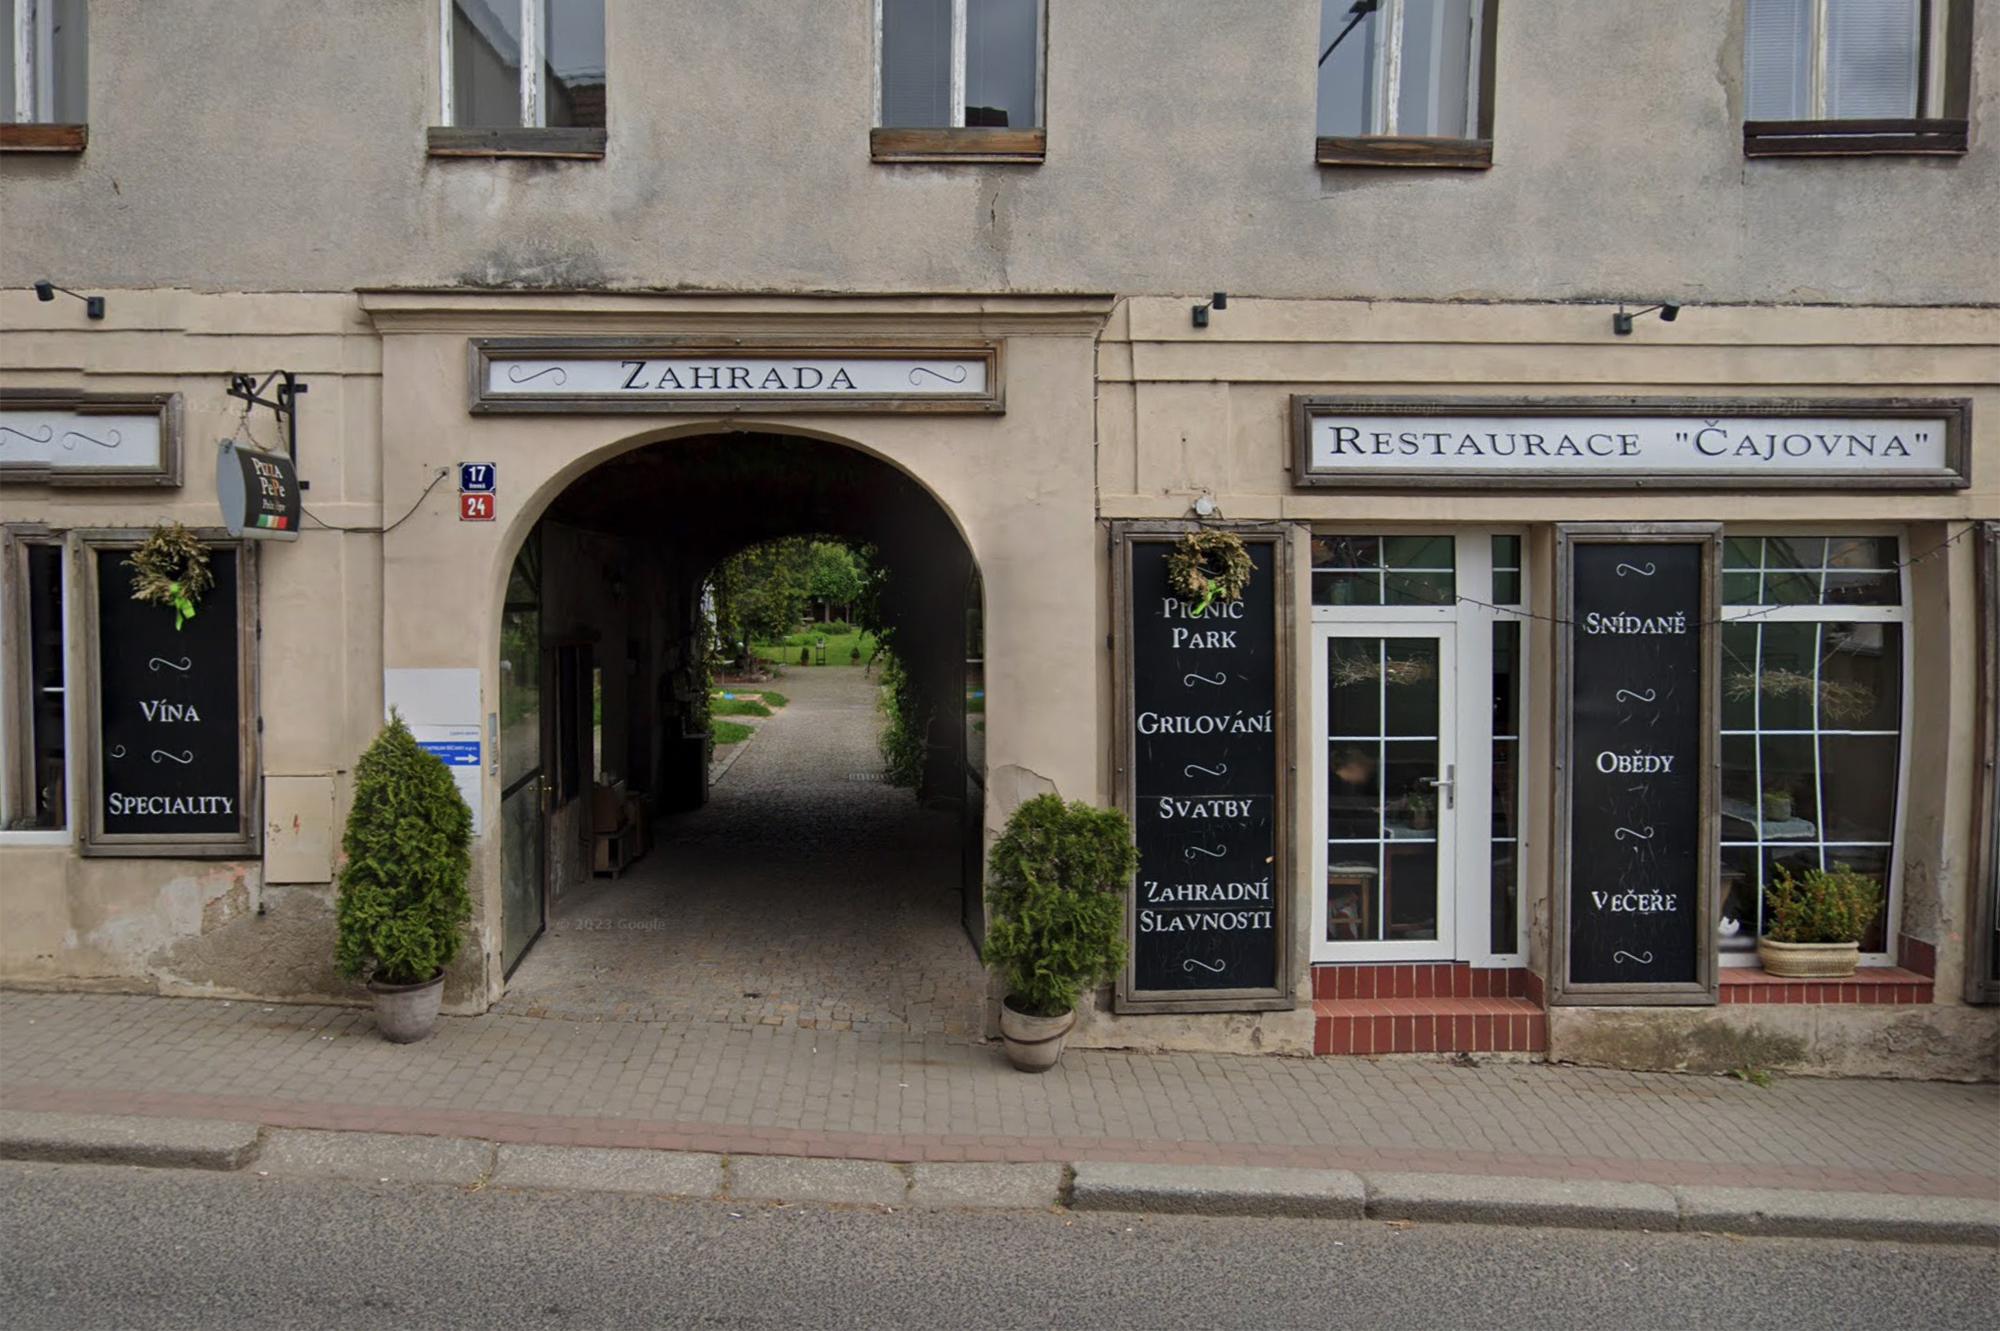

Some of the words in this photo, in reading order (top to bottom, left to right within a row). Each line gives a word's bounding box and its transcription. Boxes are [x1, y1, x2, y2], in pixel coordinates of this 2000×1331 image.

[620, 359, 858, 392] ZAHRADA
[1329, 425, 1642, 457] RESTAURACE
[1675, 420, 1931, 461] "ČAJOVNA"
[469, 466, 487, 482] 17
[468, 497, 486, 516] 24
[1586, 611, 1687, 635] SNÍDANĚ
[1171, 627, 1237, 649] PARK
[139, 700, 201, 722] VÍNA
[1137, 709, 1273, 735] GRILOVÁNÍ
[1596, 749, 1675, 774] OBĚDY
[109, 793, 235, 816] SPECIALITY
[1159, 797, 1253, 819] SVATBY
[1143, 877, 1270, 903] ZAHRADNÍ
[1591, 889, 1678, 912] VEČEŘE
[1139, 910, 1272, 933] SLAVNOSTI
